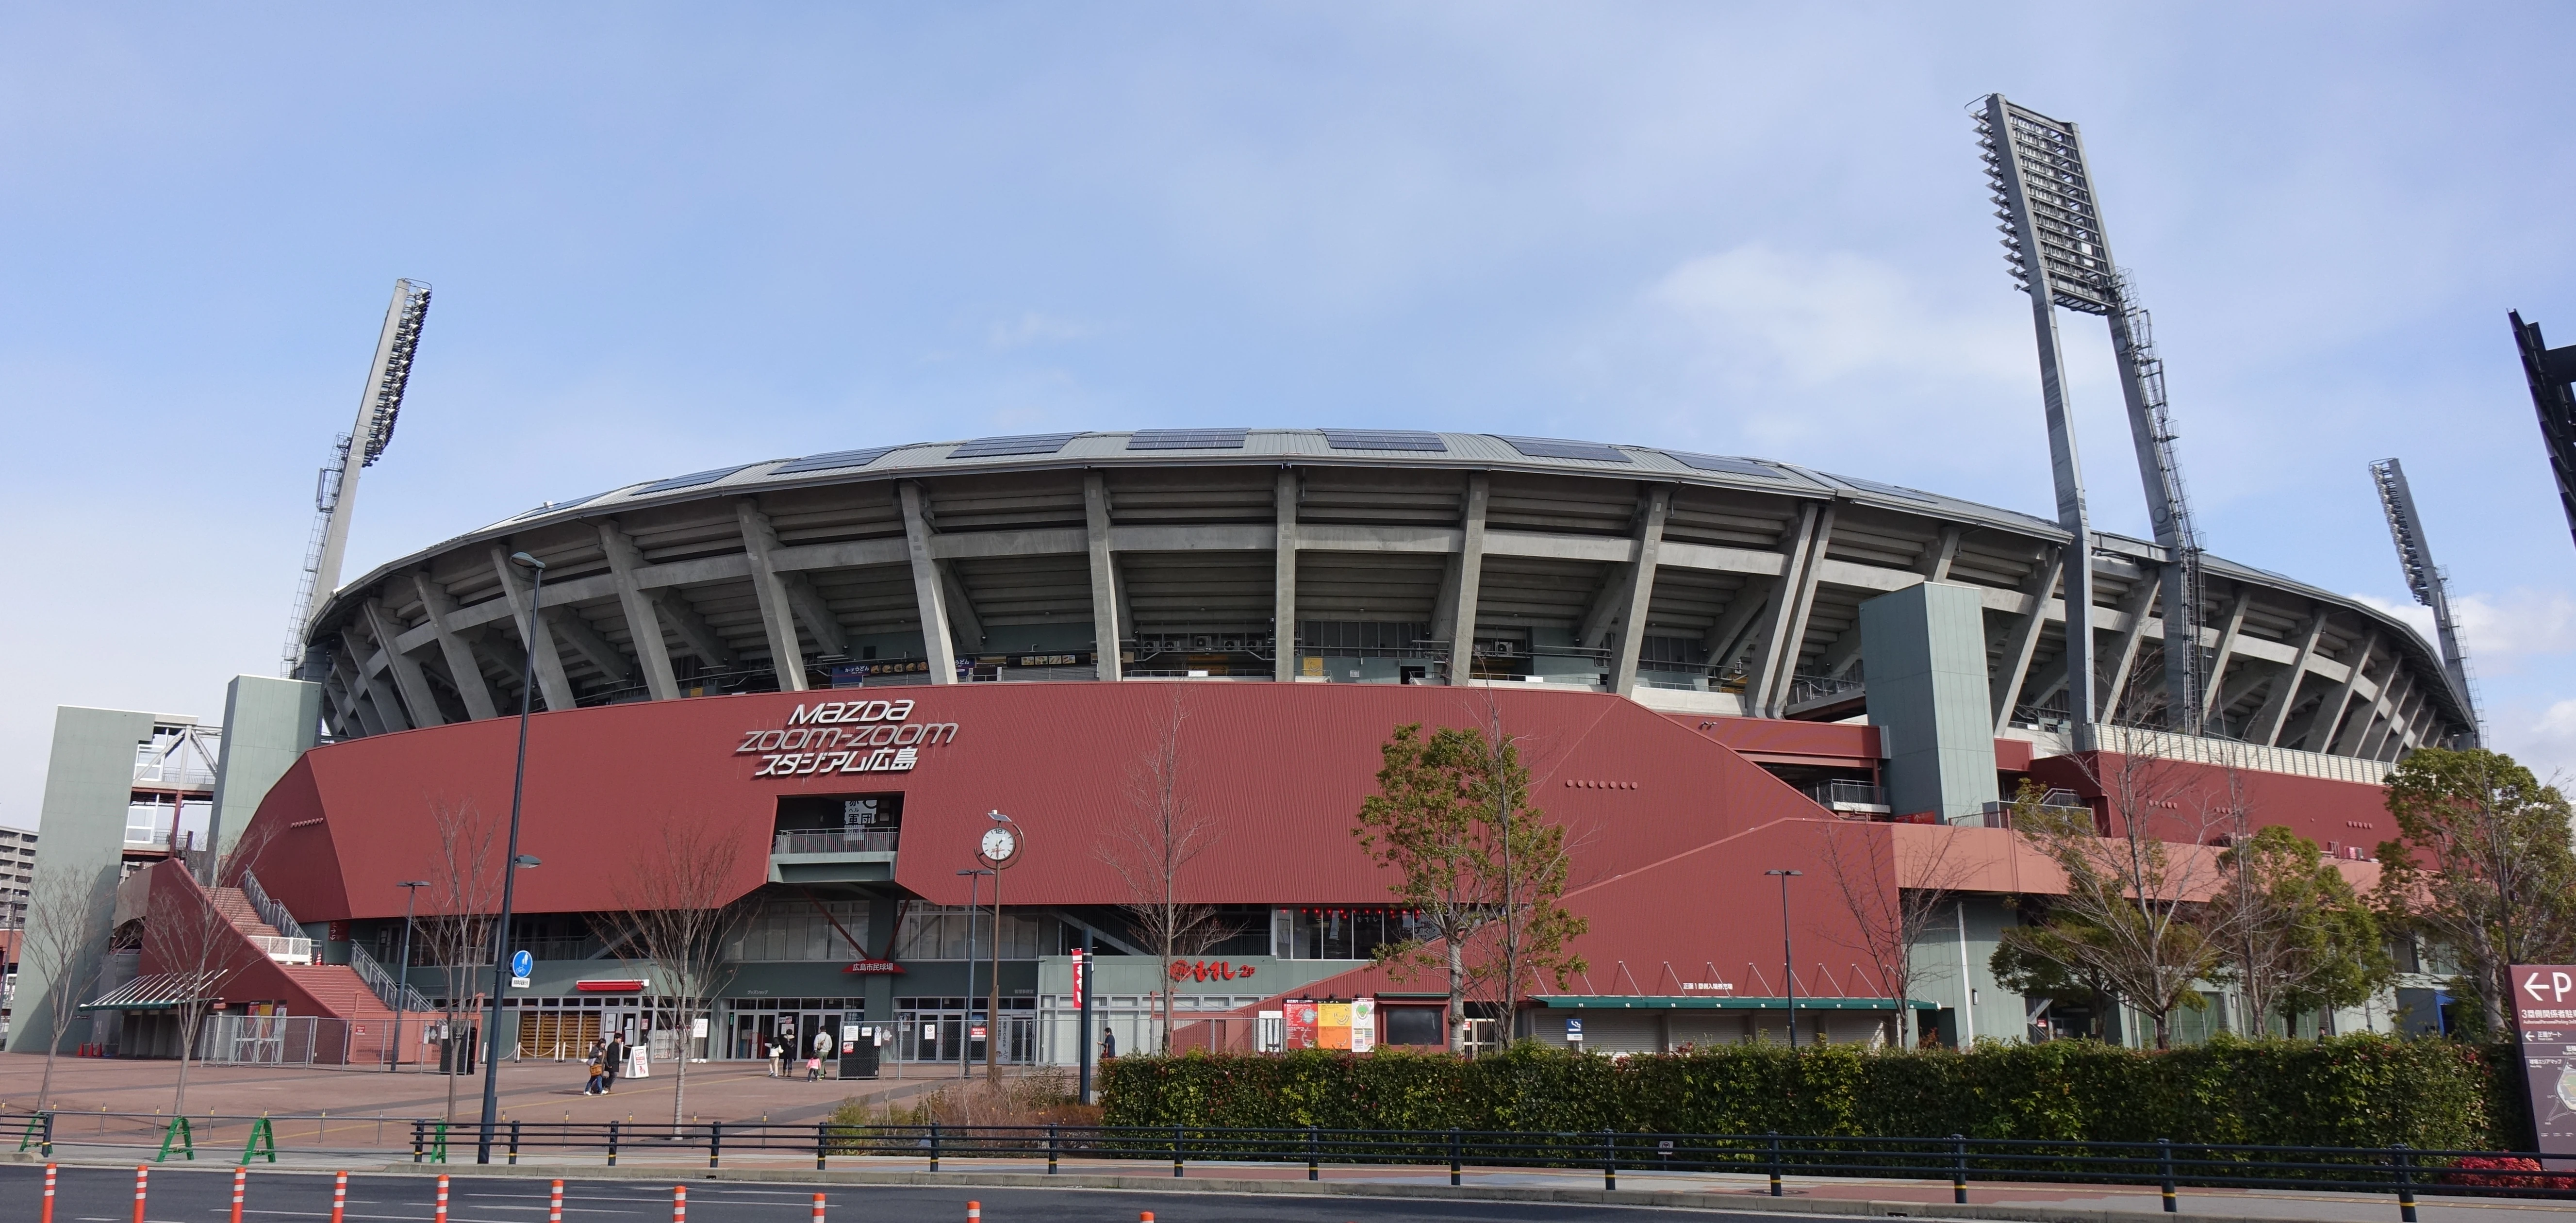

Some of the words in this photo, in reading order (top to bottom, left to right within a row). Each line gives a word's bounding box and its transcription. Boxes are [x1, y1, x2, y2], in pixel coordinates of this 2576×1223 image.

[755, 746, 919, 776] スタジアム広島
[848, 813, 872, 825] 軍団
[852, 963, 893, 971] 広島市民球場
[1194, 960, 1237, 982] むさし
[1240, 964, 1255, 977] 2F
[2552, 972, 2572, 1002] P
